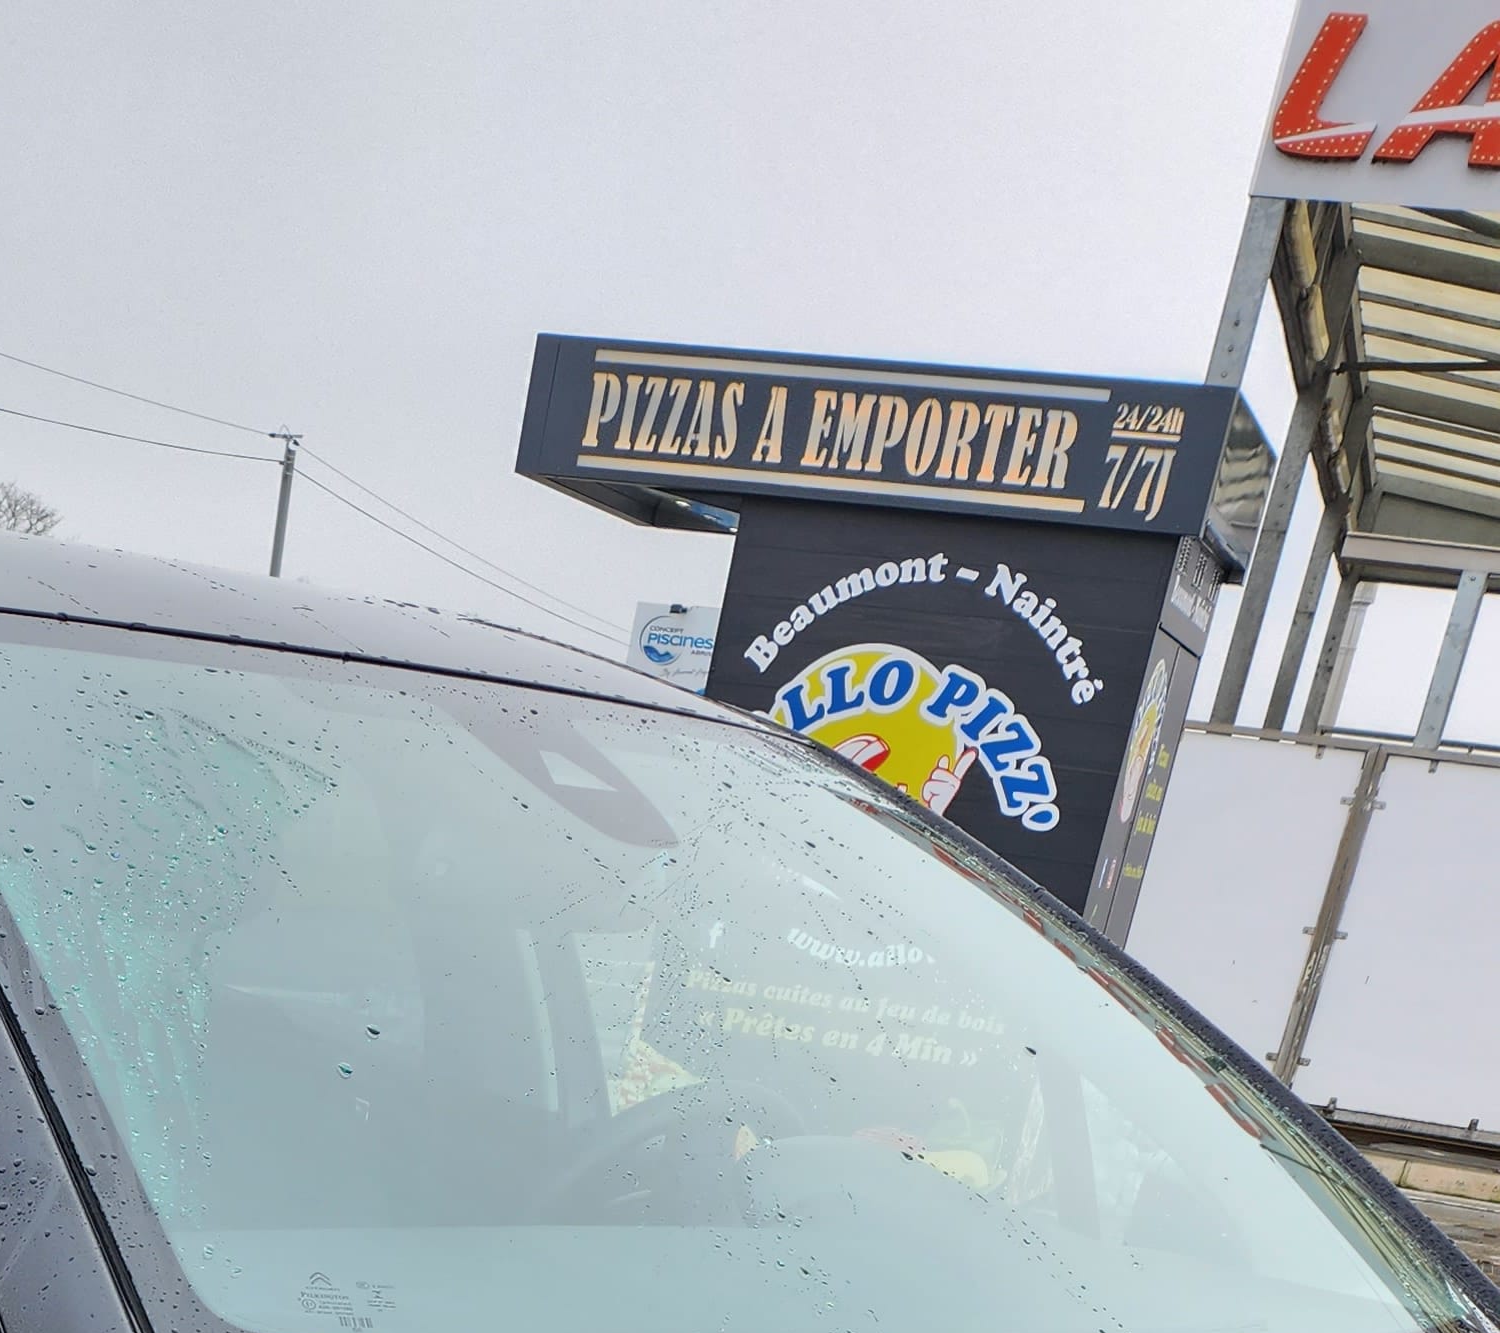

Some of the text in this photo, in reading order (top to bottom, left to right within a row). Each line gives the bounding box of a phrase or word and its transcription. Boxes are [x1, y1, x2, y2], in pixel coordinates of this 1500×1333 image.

[582, 372, 1079, 489] PIZZAS A EMPORTER
[743, 552, 949, 673] Beaumont
[984, 563, 1104, 706] Naintré
[777, 656, 918, 734] LLO
[924, 669, 1060, 832] PIZZO
[686, 968, 758, 998] Pizzas
[763, 983, 833, 1008] cuites
[876, 996, 917, 1021] feu
[922, 1004, 951, 1025] de
[958, 1009, 1006, 1035] bois
[723, 1006, 816, 1043] Prêtes
[822, 1029, 859, 1050] en
[865, 1031, 887, 1057] 4
